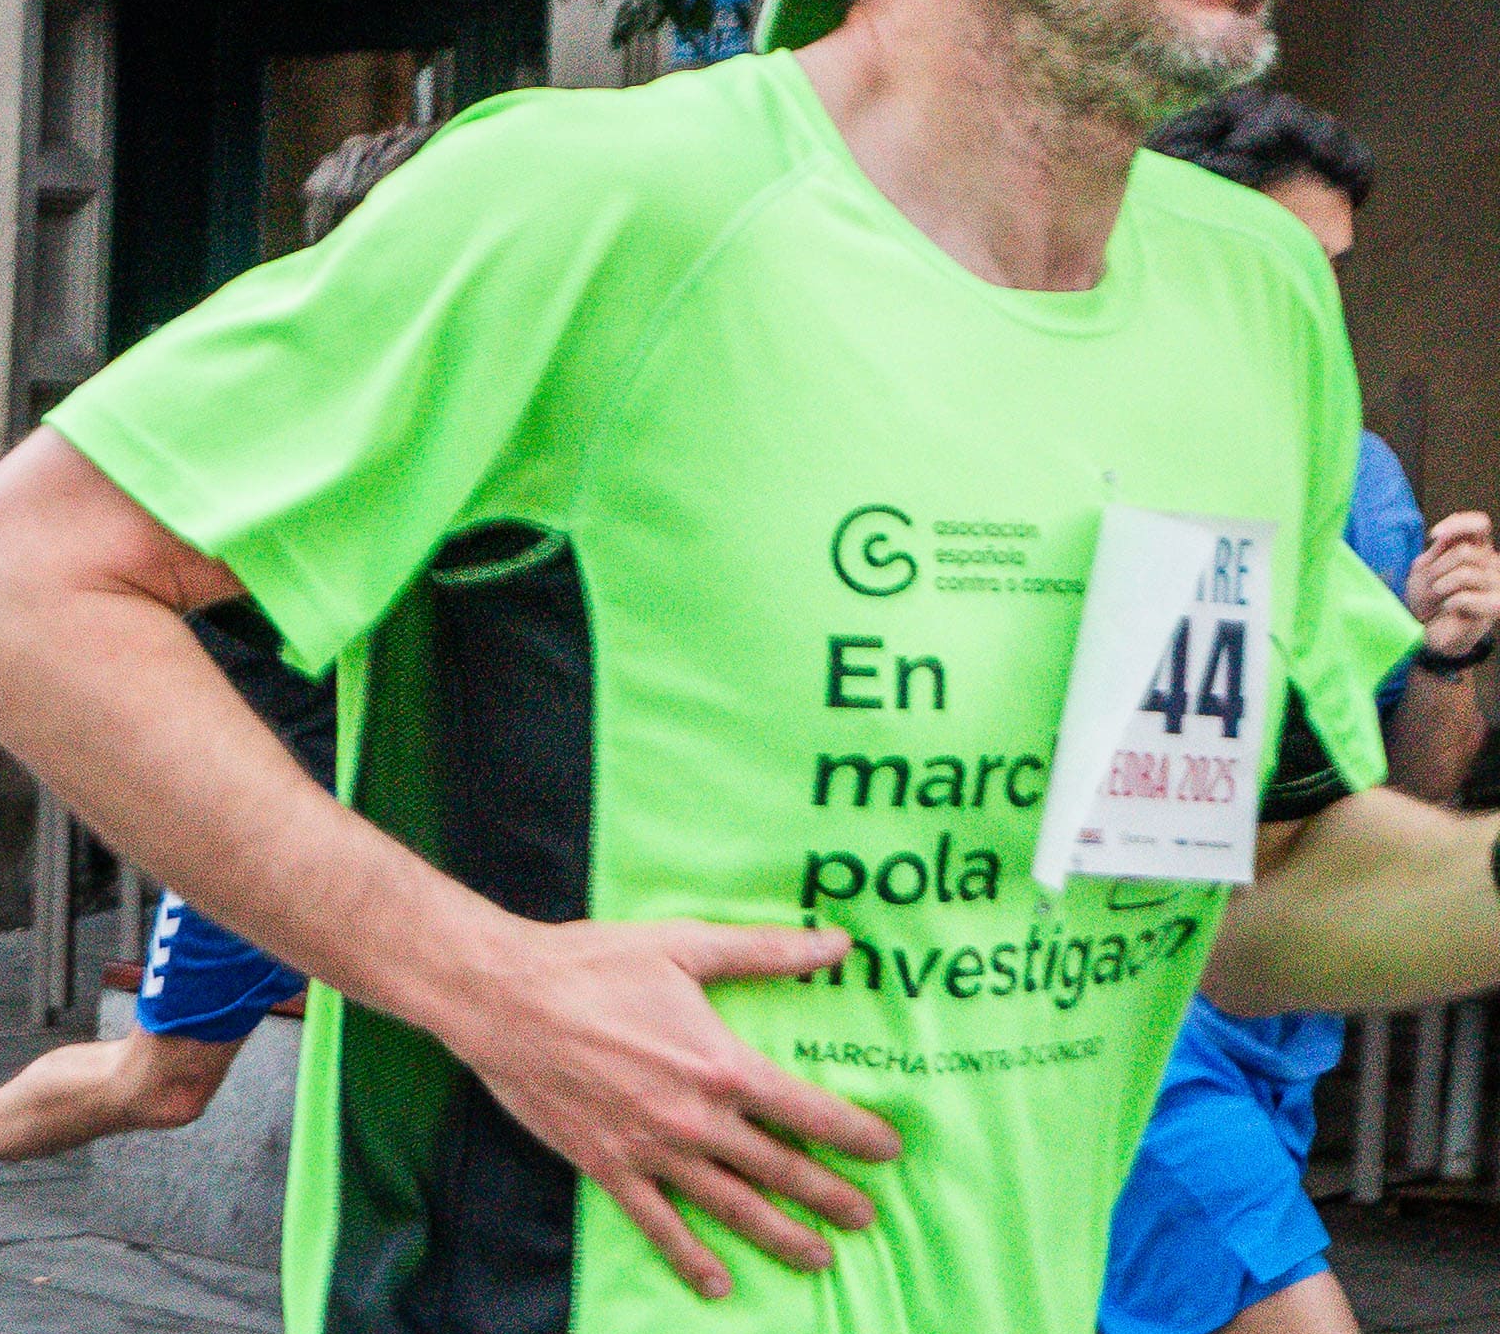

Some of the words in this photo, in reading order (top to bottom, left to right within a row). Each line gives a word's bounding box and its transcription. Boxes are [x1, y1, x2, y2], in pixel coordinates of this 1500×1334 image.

[824, 633, 948, 711] En
[1138, 615, 1248, 738] 44
[811, 742, 1057, 810] marc
[799, 832, 1000, 909] pola
[793, 1038, 930, 1074] MARCHA
